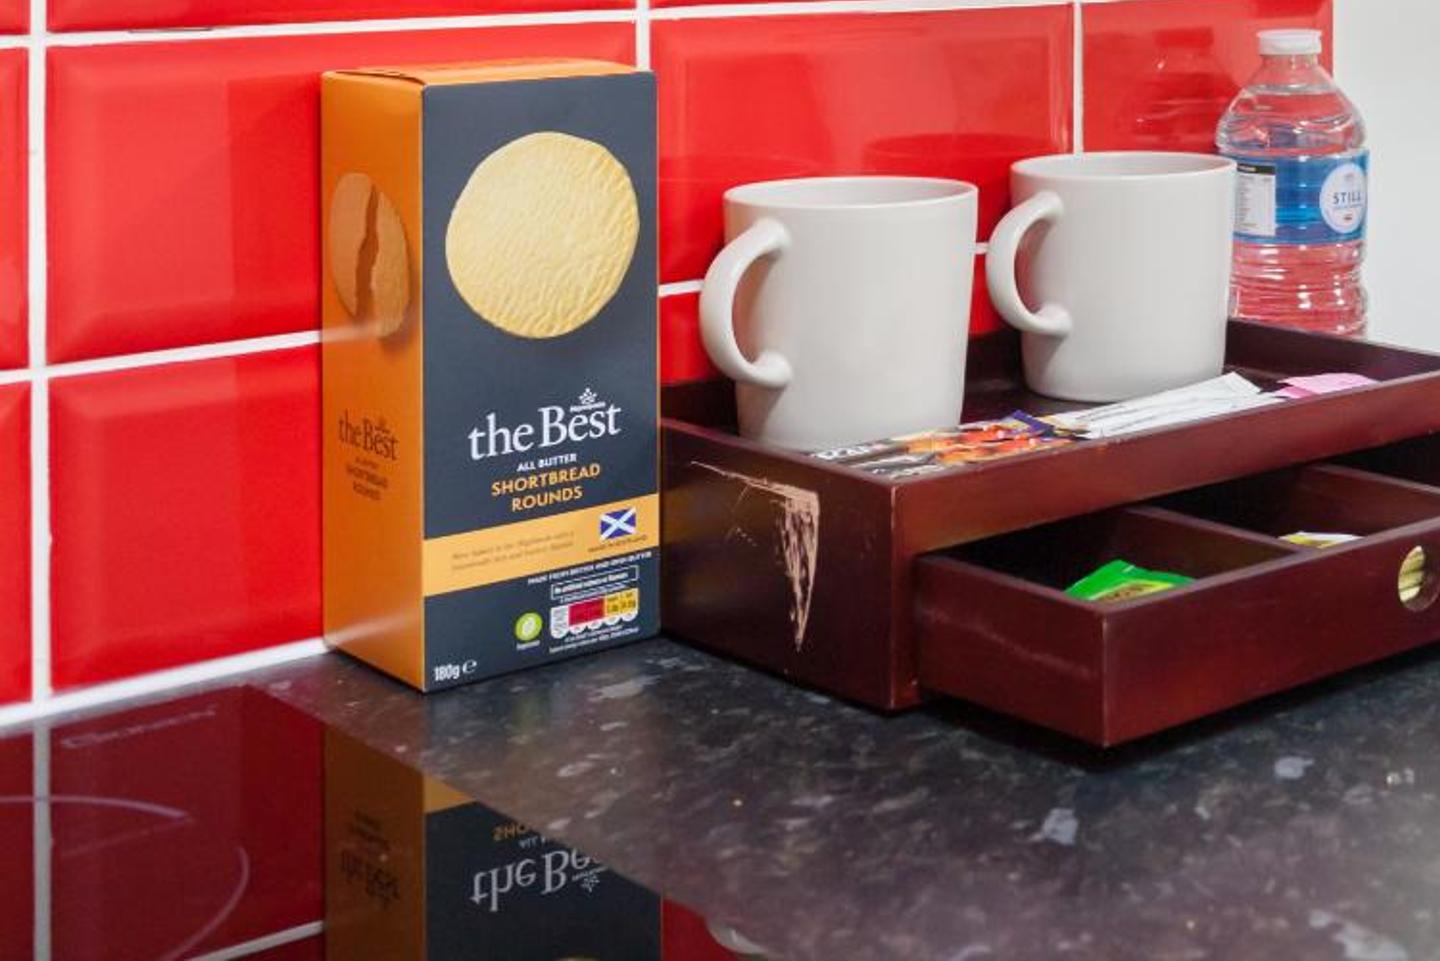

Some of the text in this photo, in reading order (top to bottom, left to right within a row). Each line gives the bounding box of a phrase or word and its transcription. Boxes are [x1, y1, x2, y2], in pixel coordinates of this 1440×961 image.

[469, 403, 622, 461] the Best
[516, 453, 578, 472] ALL BUTTER
[491, 463, 601, 496] SHORTBREAD
[512, 486, 584, 512] ROUNDS
[434, 664, 461, 681] 180g
